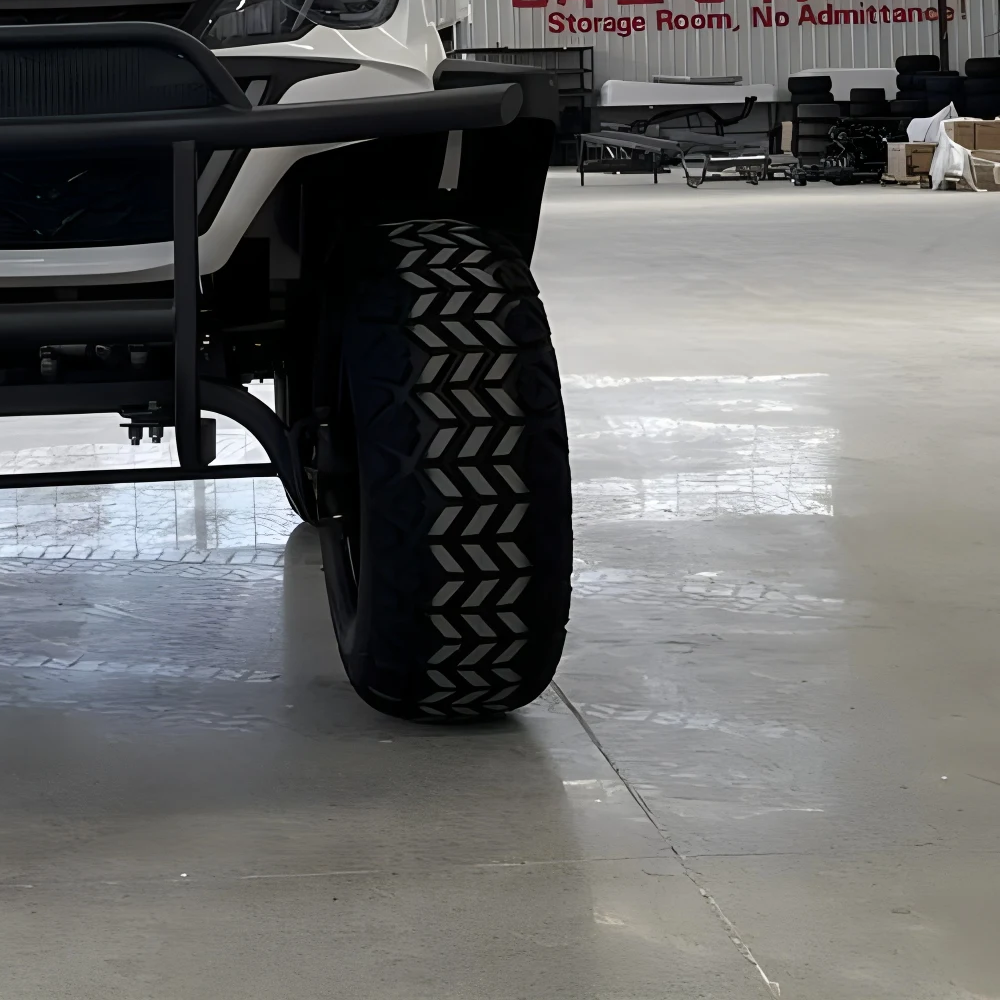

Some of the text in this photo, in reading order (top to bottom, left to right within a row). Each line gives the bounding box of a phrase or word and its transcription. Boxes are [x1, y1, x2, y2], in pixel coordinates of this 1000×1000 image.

[548, 11, 646, 37] Storage
[656, 9, 740, 32] Room,
[752, 5, 790, 28] No
